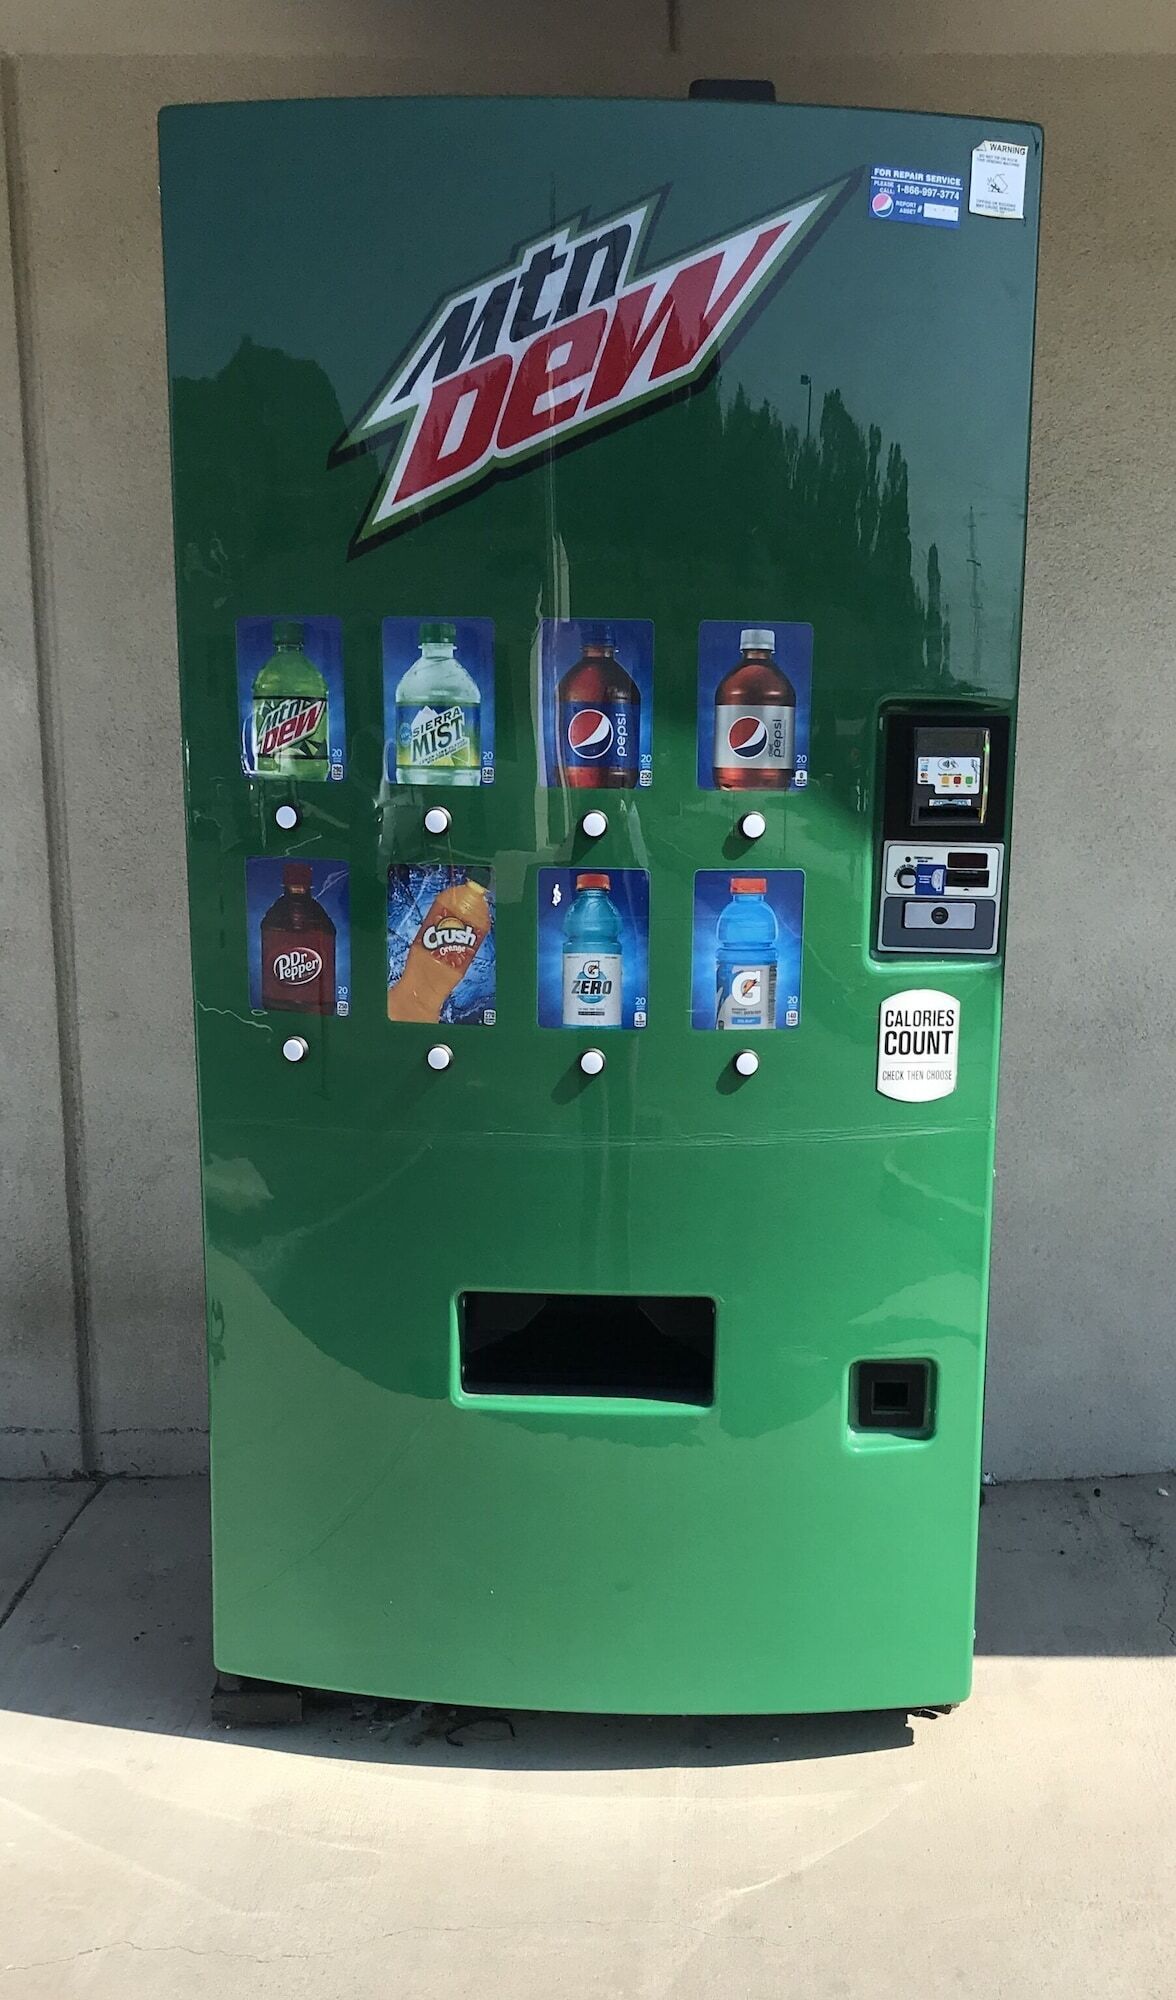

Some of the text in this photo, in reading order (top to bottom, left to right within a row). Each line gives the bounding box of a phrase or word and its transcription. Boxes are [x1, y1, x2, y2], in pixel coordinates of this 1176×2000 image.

[990, 144, 1026, 155] WARNING
[874, 168, 961, 186] FOR REPAIR SERVICE
[896, 184, 960, 200] 1-866-997-3774
[895, 200, 917, 208] REPORT
[392, 223, 632, 403] Mtn
[413, 707, 461, 737] SIERRA
[412, 715, 463, 762] MIST
[615, 713, 628, 757] pepsi
[772, 719, 783, 757] pepsi
[331, 748, 343, 757] 20
[482, 751, 493, 760] 20
[640, 754, 652, 763] 20
[796, 754, 807, 763] 20
[423, 925, 477, 949] Crush
[439, 945, 466, 956] Orange
[278, 954, 319, 980] Pepper
[290, 951, 308, 967] Dr
[582, 960, 600, 979] G
[337, 986, 348, 994] 20
[571, 980, 613, 995] ZERO
[731, 970, 761, 1006] G
[635, 997, 646, 1006] 20
[787, 995, 798, 1004] 20
[885, 1009, 954, 1027] CALORIES
[884, 1030, 954, 1055] COUNT
[882, 1070, 952, 1081] CHECK THEN CHOOSE
